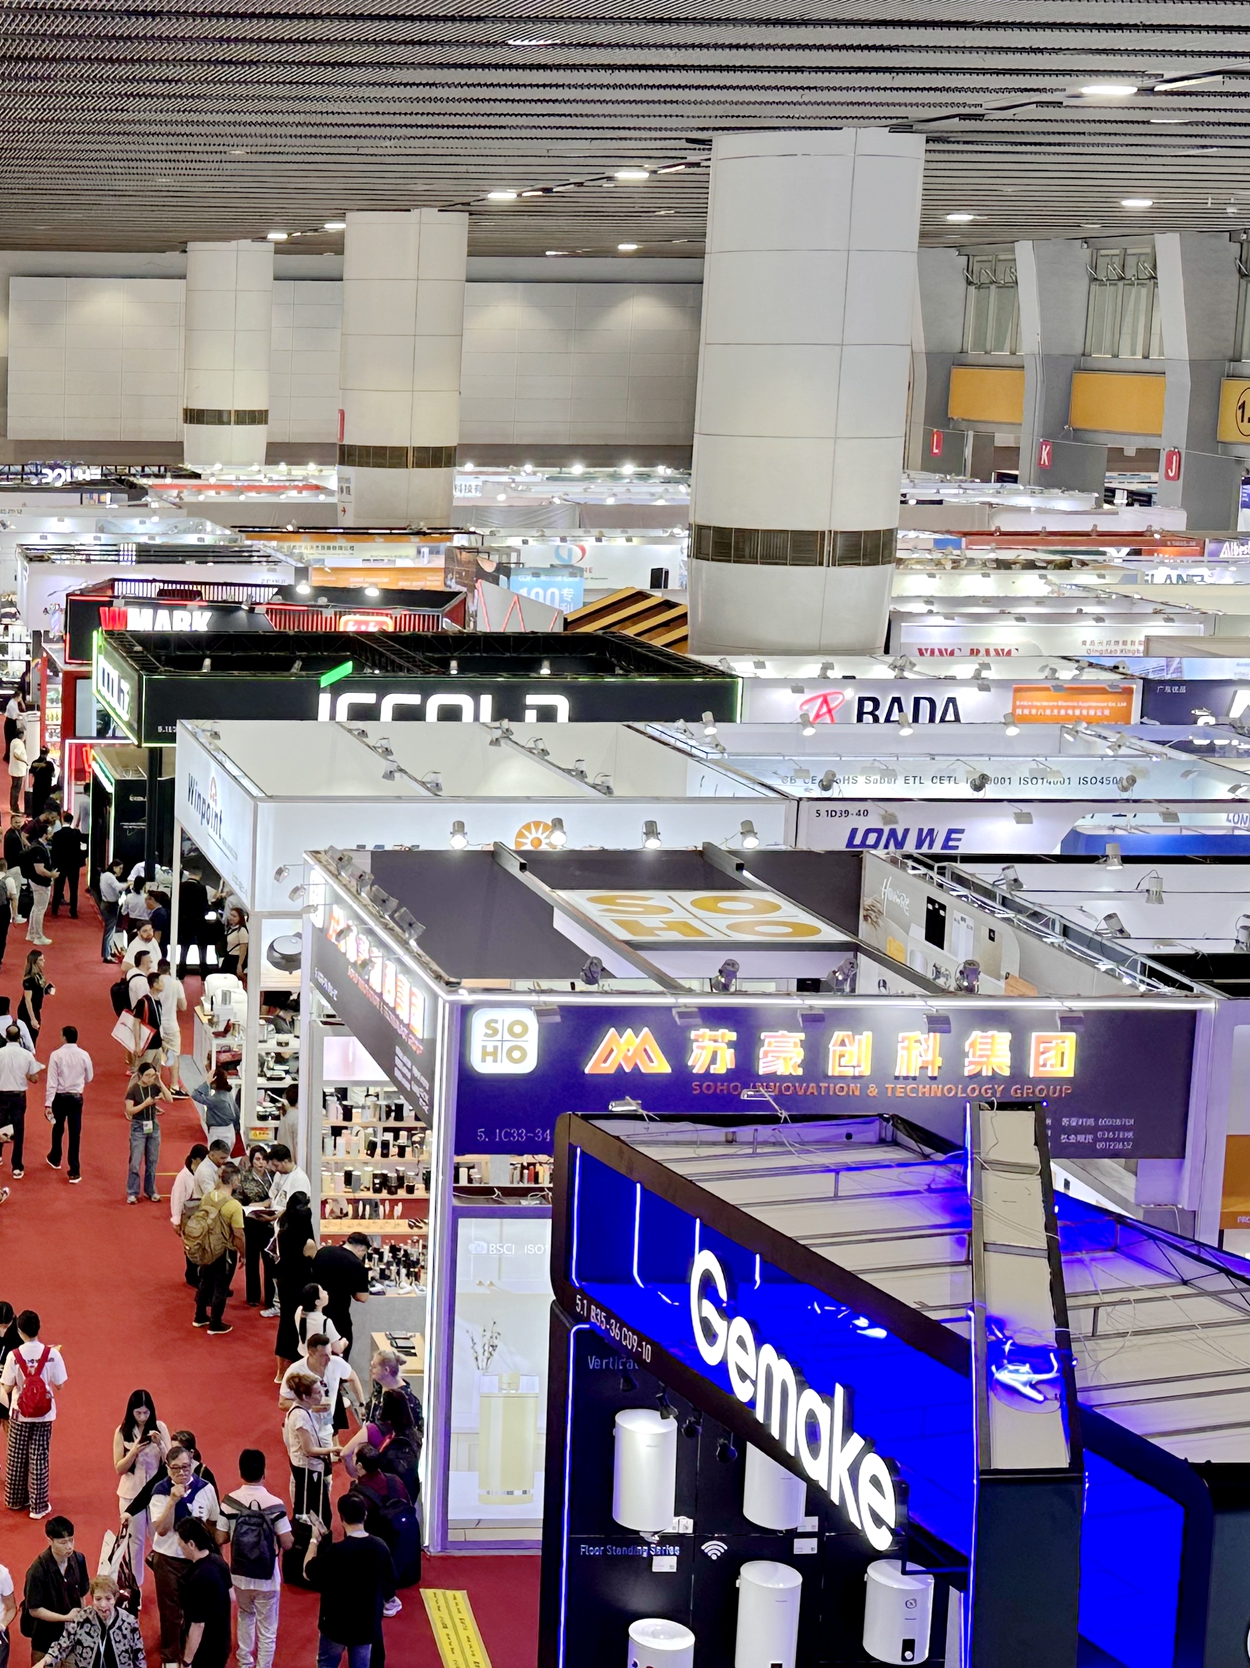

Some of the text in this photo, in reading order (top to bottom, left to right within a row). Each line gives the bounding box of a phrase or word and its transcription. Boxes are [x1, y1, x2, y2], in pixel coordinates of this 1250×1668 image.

[933, 434, 939, 453] L
[1040, 444, 1049, 466] K
[1167, 455, 1176, 477] J
[99, 606, 213, 632] WMARK
[904, 776, 925, 785] ETL
[931, 776, 958, 785] CETL
[187, 772, 224, 840] Winpoint
[687, 1028, 1077, 1079] 苏豪创科集团
[692, 1080, 741, 1095] SOHO
[867, 1085, 878, 1097] &
[884, 1083, 1005, 1099] TECHNOLOGY
[1010, 1084, 1073, 1099] GROUP
[488, 1243, 515, 1255] BSCI
[575, 1294, 588, 1317] 5.1
[690, 1249, 897, 1551] Gemake
[580, 1543, 680, 1558] Floor Standing Series
